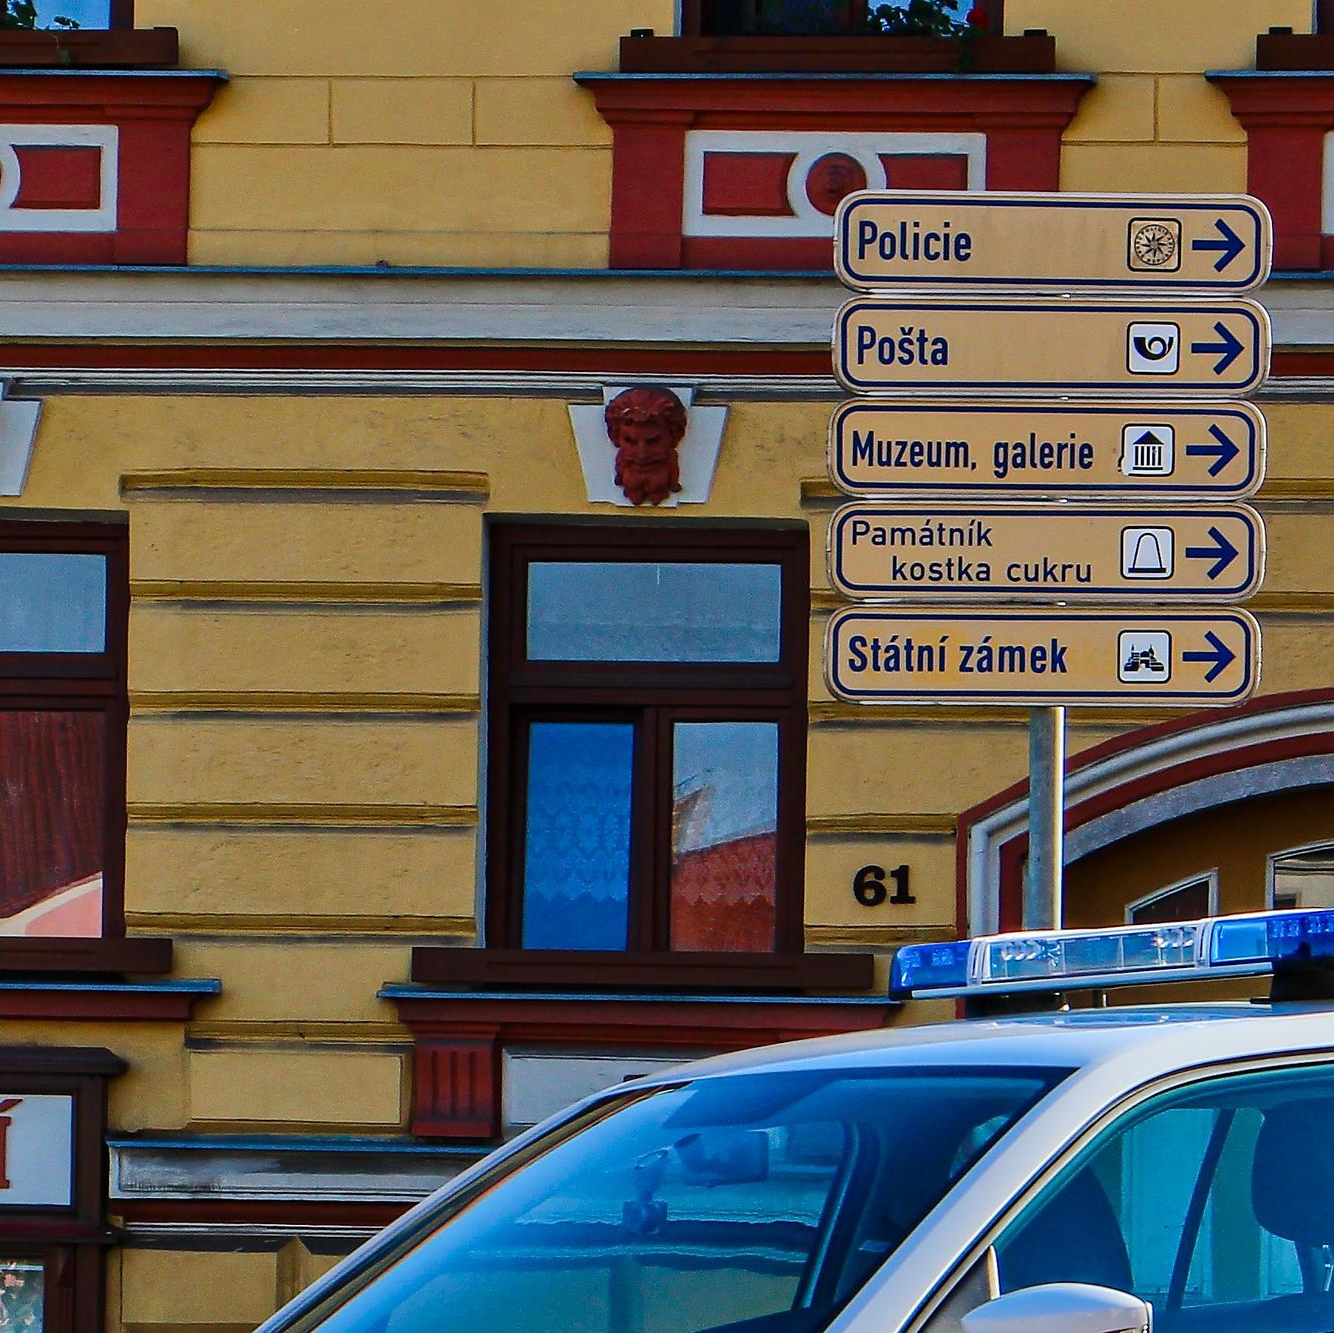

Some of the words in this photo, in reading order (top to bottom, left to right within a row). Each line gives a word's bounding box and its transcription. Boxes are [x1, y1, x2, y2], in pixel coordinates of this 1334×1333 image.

[857, 221, 972, 261] Policie
[856, 325, 950, 367] Pošta
[851, 430, 977, 471] Muzeum,
[993, 432, 1095, 478] galerie
[851, 519, 993, 547] Památník
[891, 555, 992, 582] kostka
[1006, 557, 1093, 583] cukru
[847, 635, 950, 673] Státní
[959, 637, 1068, 674] zámek
[853, 864, 916, 907] 61
